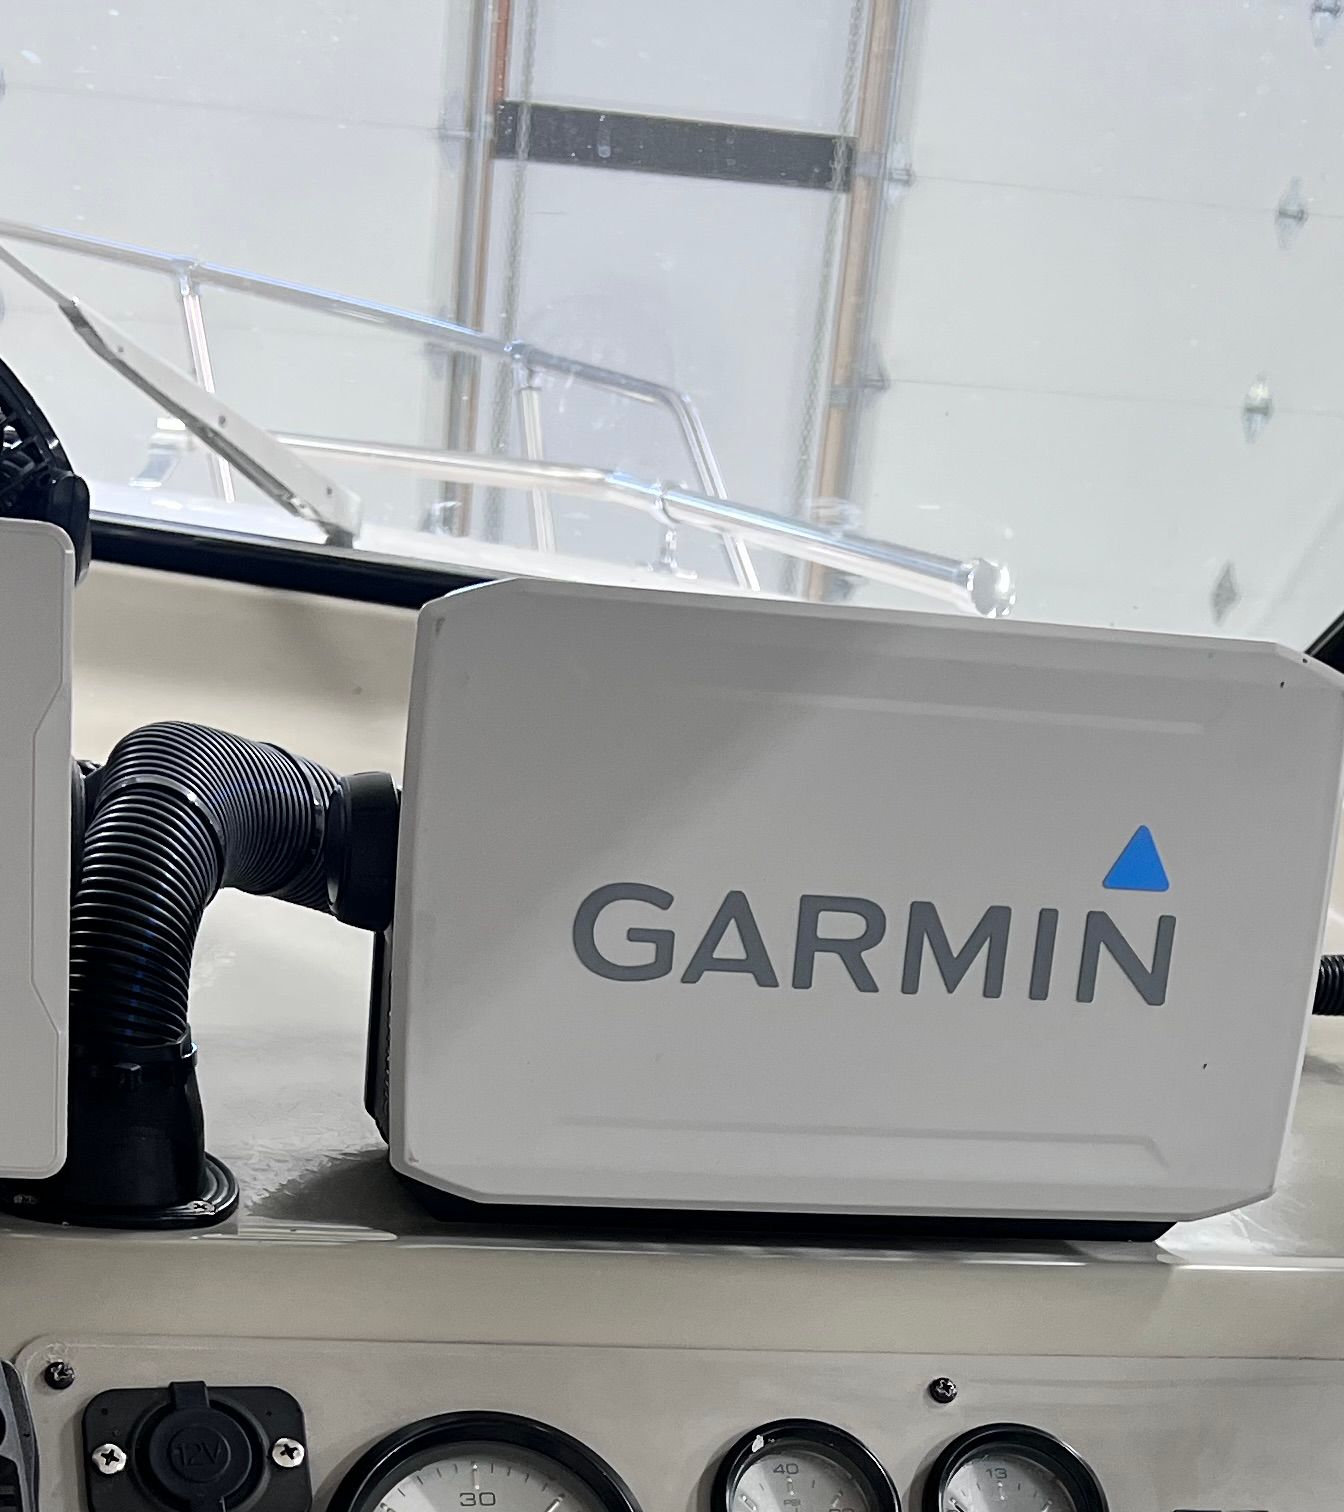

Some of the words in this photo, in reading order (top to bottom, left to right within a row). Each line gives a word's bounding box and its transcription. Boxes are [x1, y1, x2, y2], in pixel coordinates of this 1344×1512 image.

[572, 882, 1177, 1006] GARMIN
[773, 1463, 799, 1475] 40
[985, 1467, 1007, 1479] 13
[459, 1492, 496, 1507] 30
